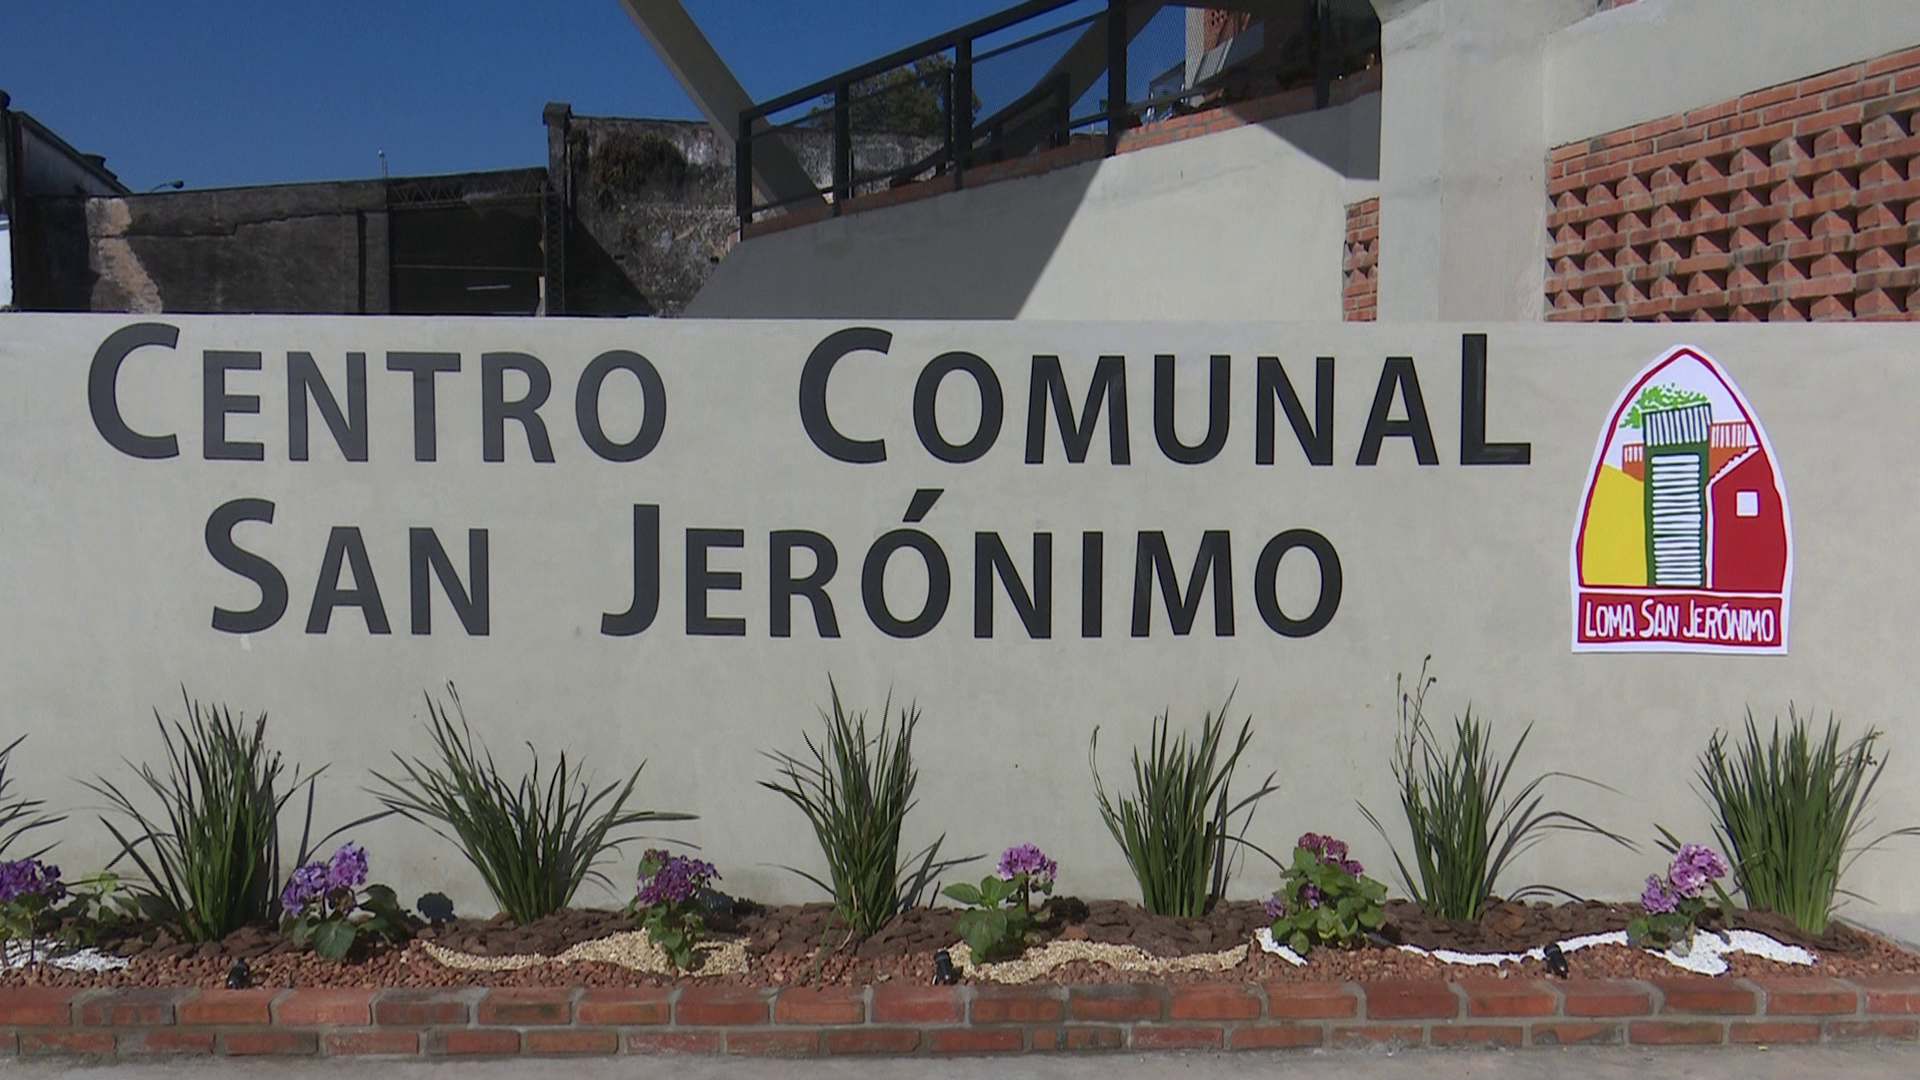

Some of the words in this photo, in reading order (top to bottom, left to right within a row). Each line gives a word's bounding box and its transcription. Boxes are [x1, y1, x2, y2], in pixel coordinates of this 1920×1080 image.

[88, 323, 666, 463] CENTRO
[799, 327, 1532, 467] COMUNAL
[205, 499, 490, 637] SAN
[601, 489, 1343, 639] JERÓNIMO
[1586, 601, 1635, 637] LOMA
[1639, 598, 1680, 639] SAN
[1683, 600, 1775, 642] JERÓNIMO
